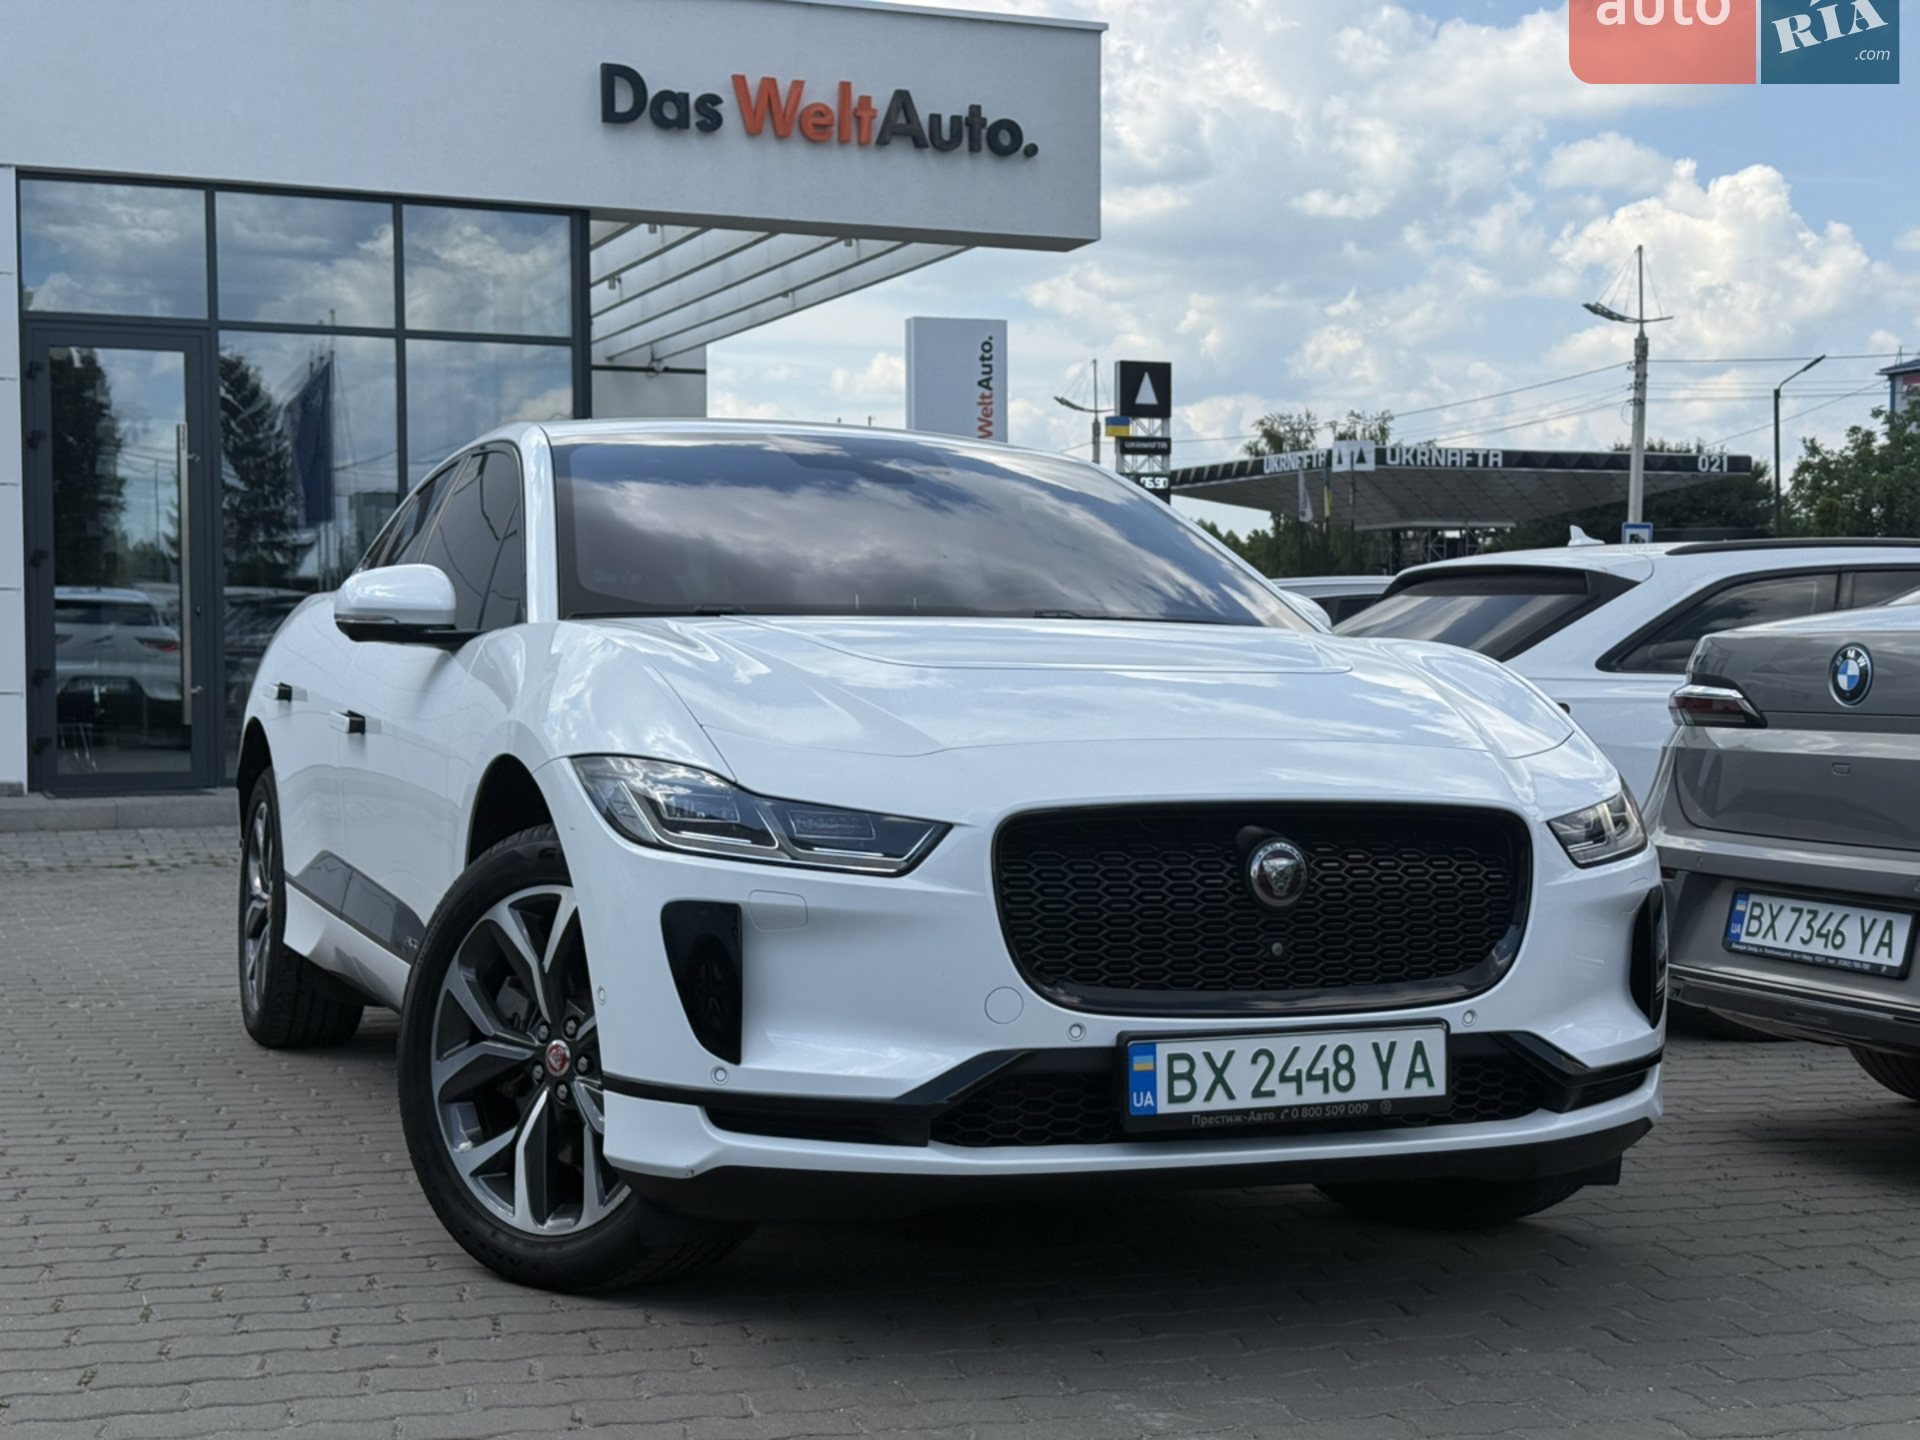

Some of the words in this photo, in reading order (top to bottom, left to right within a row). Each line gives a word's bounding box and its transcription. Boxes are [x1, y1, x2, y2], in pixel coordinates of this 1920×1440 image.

[600, 62, 724, 133] Das
[1385, 446, 1503, 468] UKRNAFTA
[1697, 455, 1728, 473] 021
[1835, 649, 1867, 667] BMW
[1730, 922, 1741, 935] UA
[1745, 901, 1784, 941] BX
[1785, 906, 1850, 950] 7346
[1859, 915, 1894, 959] YA
[1166, 1049, 1237, 1105] BX
[1250, 1043, 1356, 1099] 2448
[1371, 1039, 1436, 1091] YA
[1132, 1091, 1155, 1108] UA
[1291, 1108, 1299, 1119] 0
[1301, 1106, 1323, 1118] 800
[1325, 1105, 1345, 1117] 509
[1347, 1103, 1369, 1115] 009
